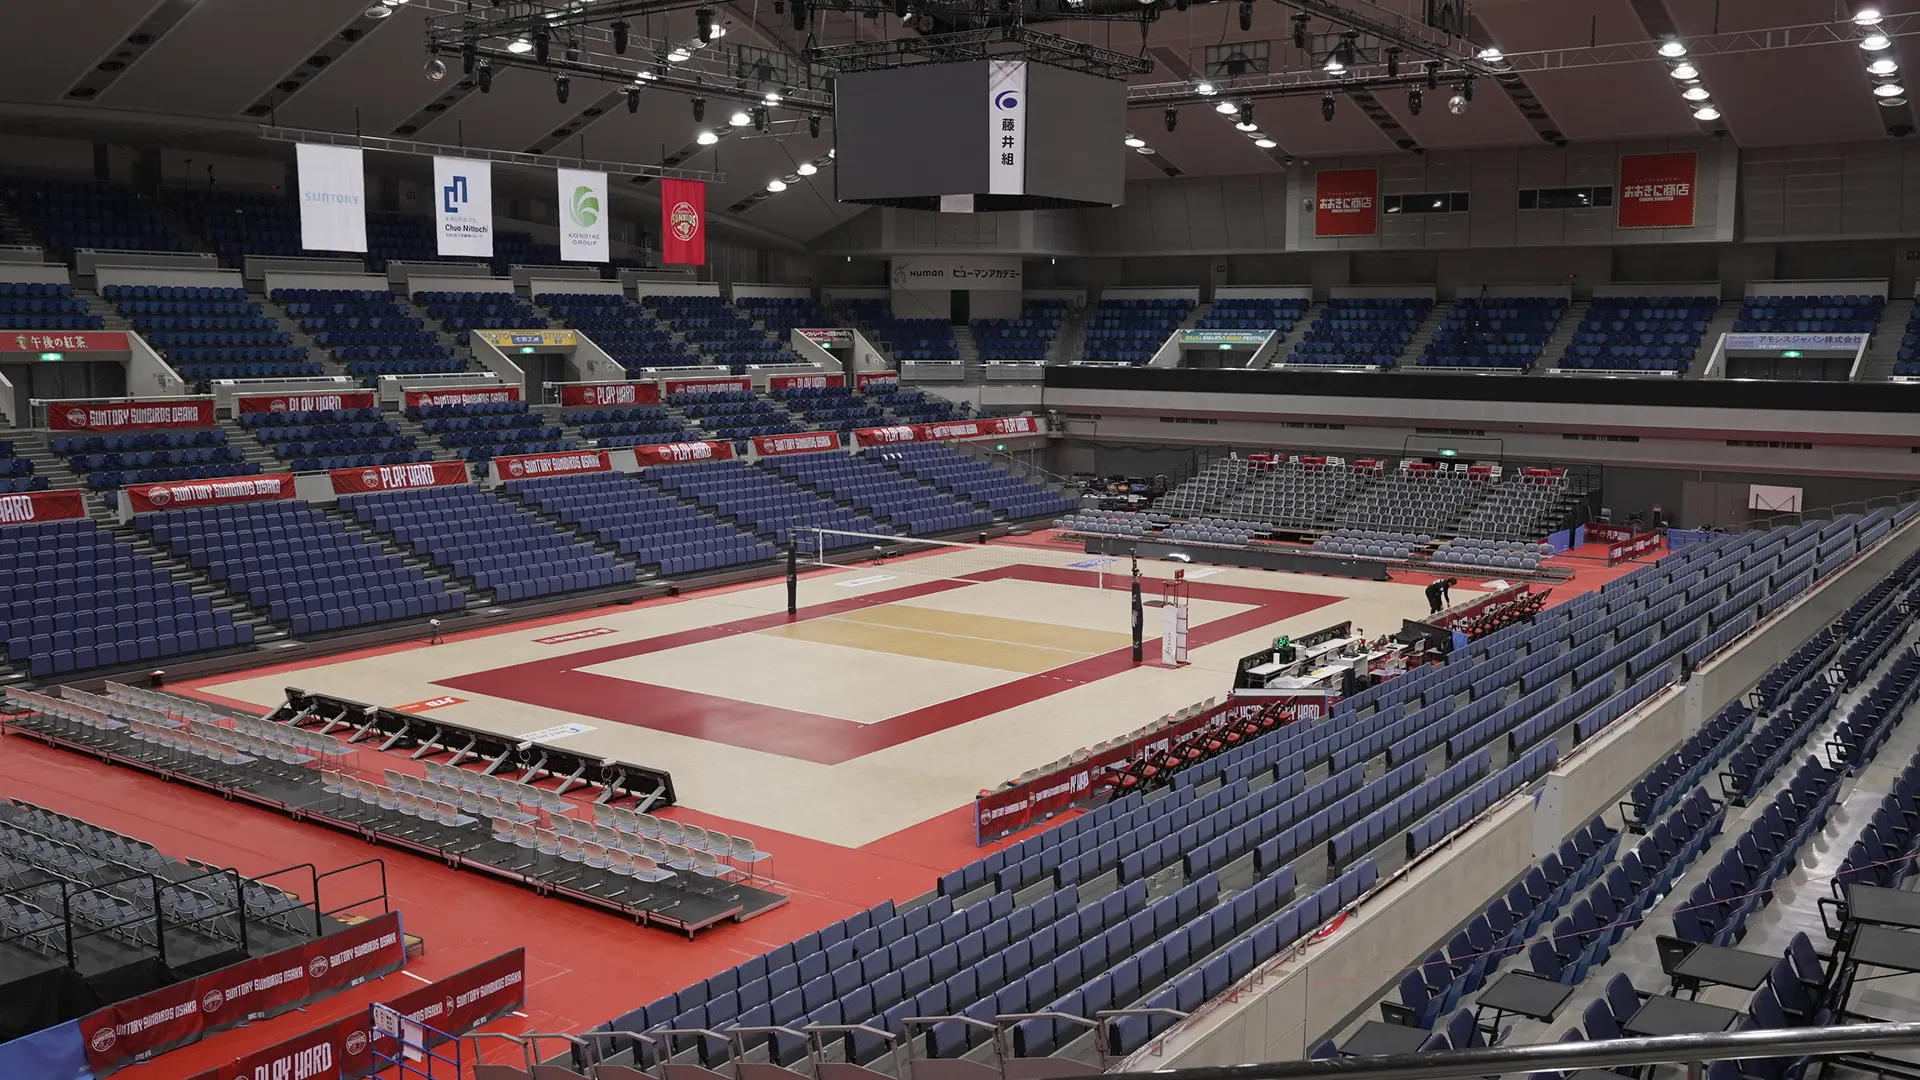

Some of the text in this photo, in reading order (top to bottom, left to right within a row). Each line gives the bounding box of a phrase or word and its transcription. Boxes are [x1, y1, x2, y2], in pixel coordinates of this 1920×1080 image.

[1001, 118, 1015, 166] 藤井組
[305, 192, 360, 205] SUNTORY
[1624, 183, 1690, 198] おおきに商店
[1319, 197, 1373, 210] おおきに商店
[445, 223, 488, 233] Chuo Nittochi
[30, 335, 86, 349] 午後の紅茶
[1759, 335, 1862, 344] アモシスジャパン株式会社
[597, 385, 635, 405] PLAY HARD
[90, 406, 199, 426] SUNTORY SUNBIRDS OSAKA
[1003, 417, 1029, 433] PLAY HARD
[669, 442, 712, 460] PLAY HARD
[523, 454, 600, 474] SUNTORY SUNBIRDS OSAKA
[380, 464, 435, 489] PLAY HARD
[172, 479, 281, 502] SUNTORY SUNBIRDS OSAKA
[1297, 704, 1320, 720] HARD
[329, 931, 397, 968] SUNTORY SUNBIRDS OSAKA
[225, 966, 304, 1002] SUNTORY SUNBIRDS OSAKA
[456, 970, 522, 1008] SUNTORY SUNBIRDS OSAKA
[116, 1000, 197, 1036] UNTORY SUNBIRDS OSAKA
[424, 1002, 443, 1021] OSAKA
[294, 1042, 333, 1080] HARD
